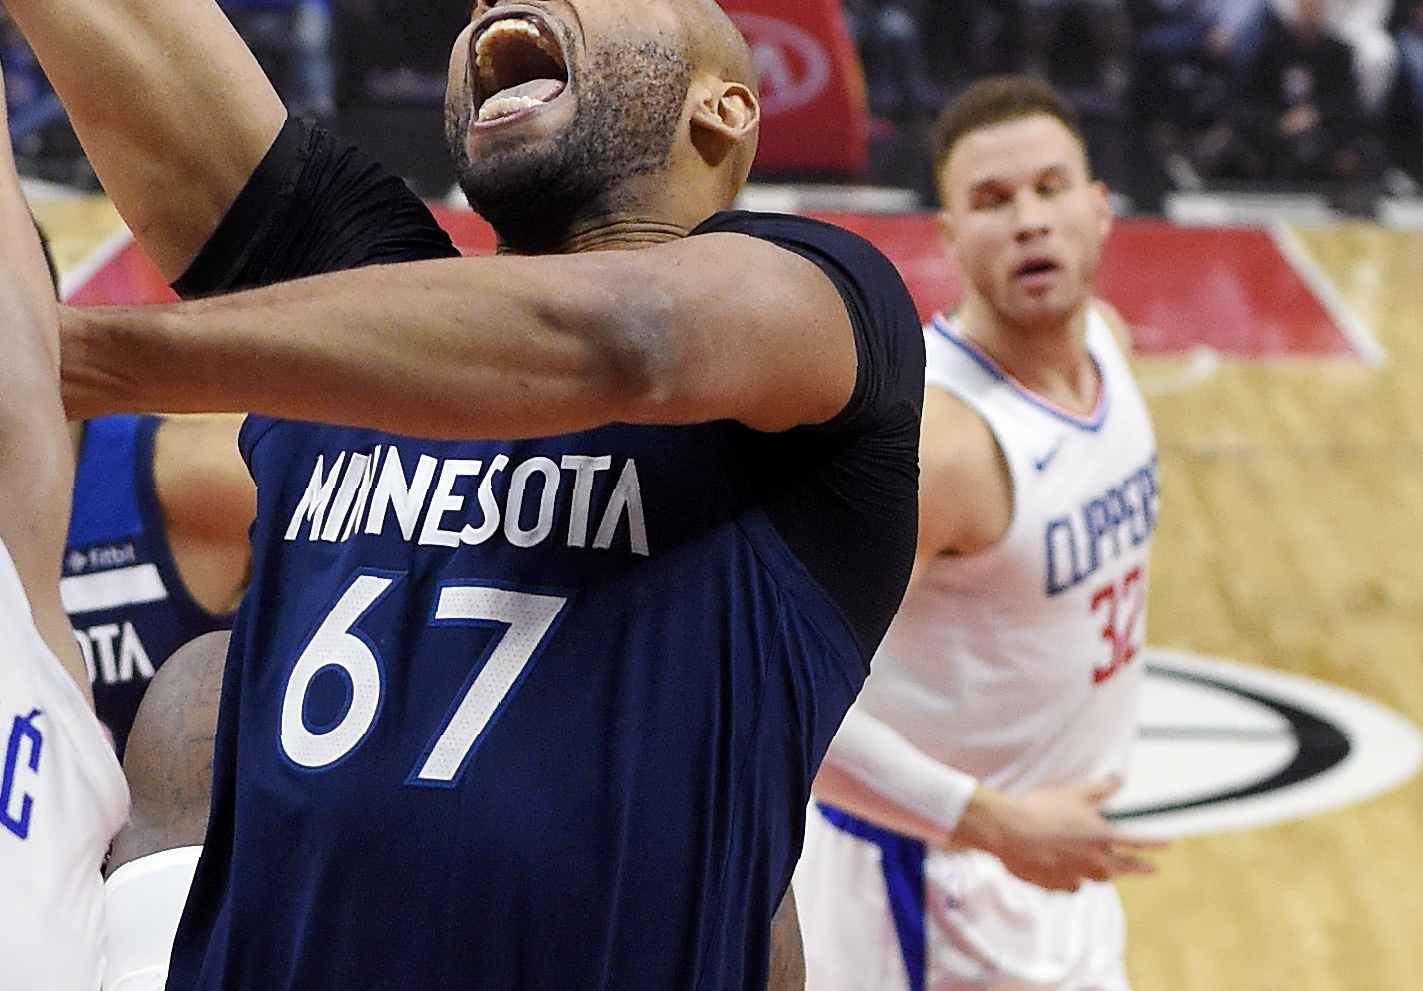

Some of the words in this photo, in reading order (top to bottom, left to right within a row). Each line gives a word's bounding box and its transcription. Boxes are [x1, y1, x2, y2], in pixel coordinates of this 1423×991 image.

[284, 444, 650, 557] MINNESOTA
[278, 568, 574, 786] 67
[1090, 566, 1144, 687] 32
